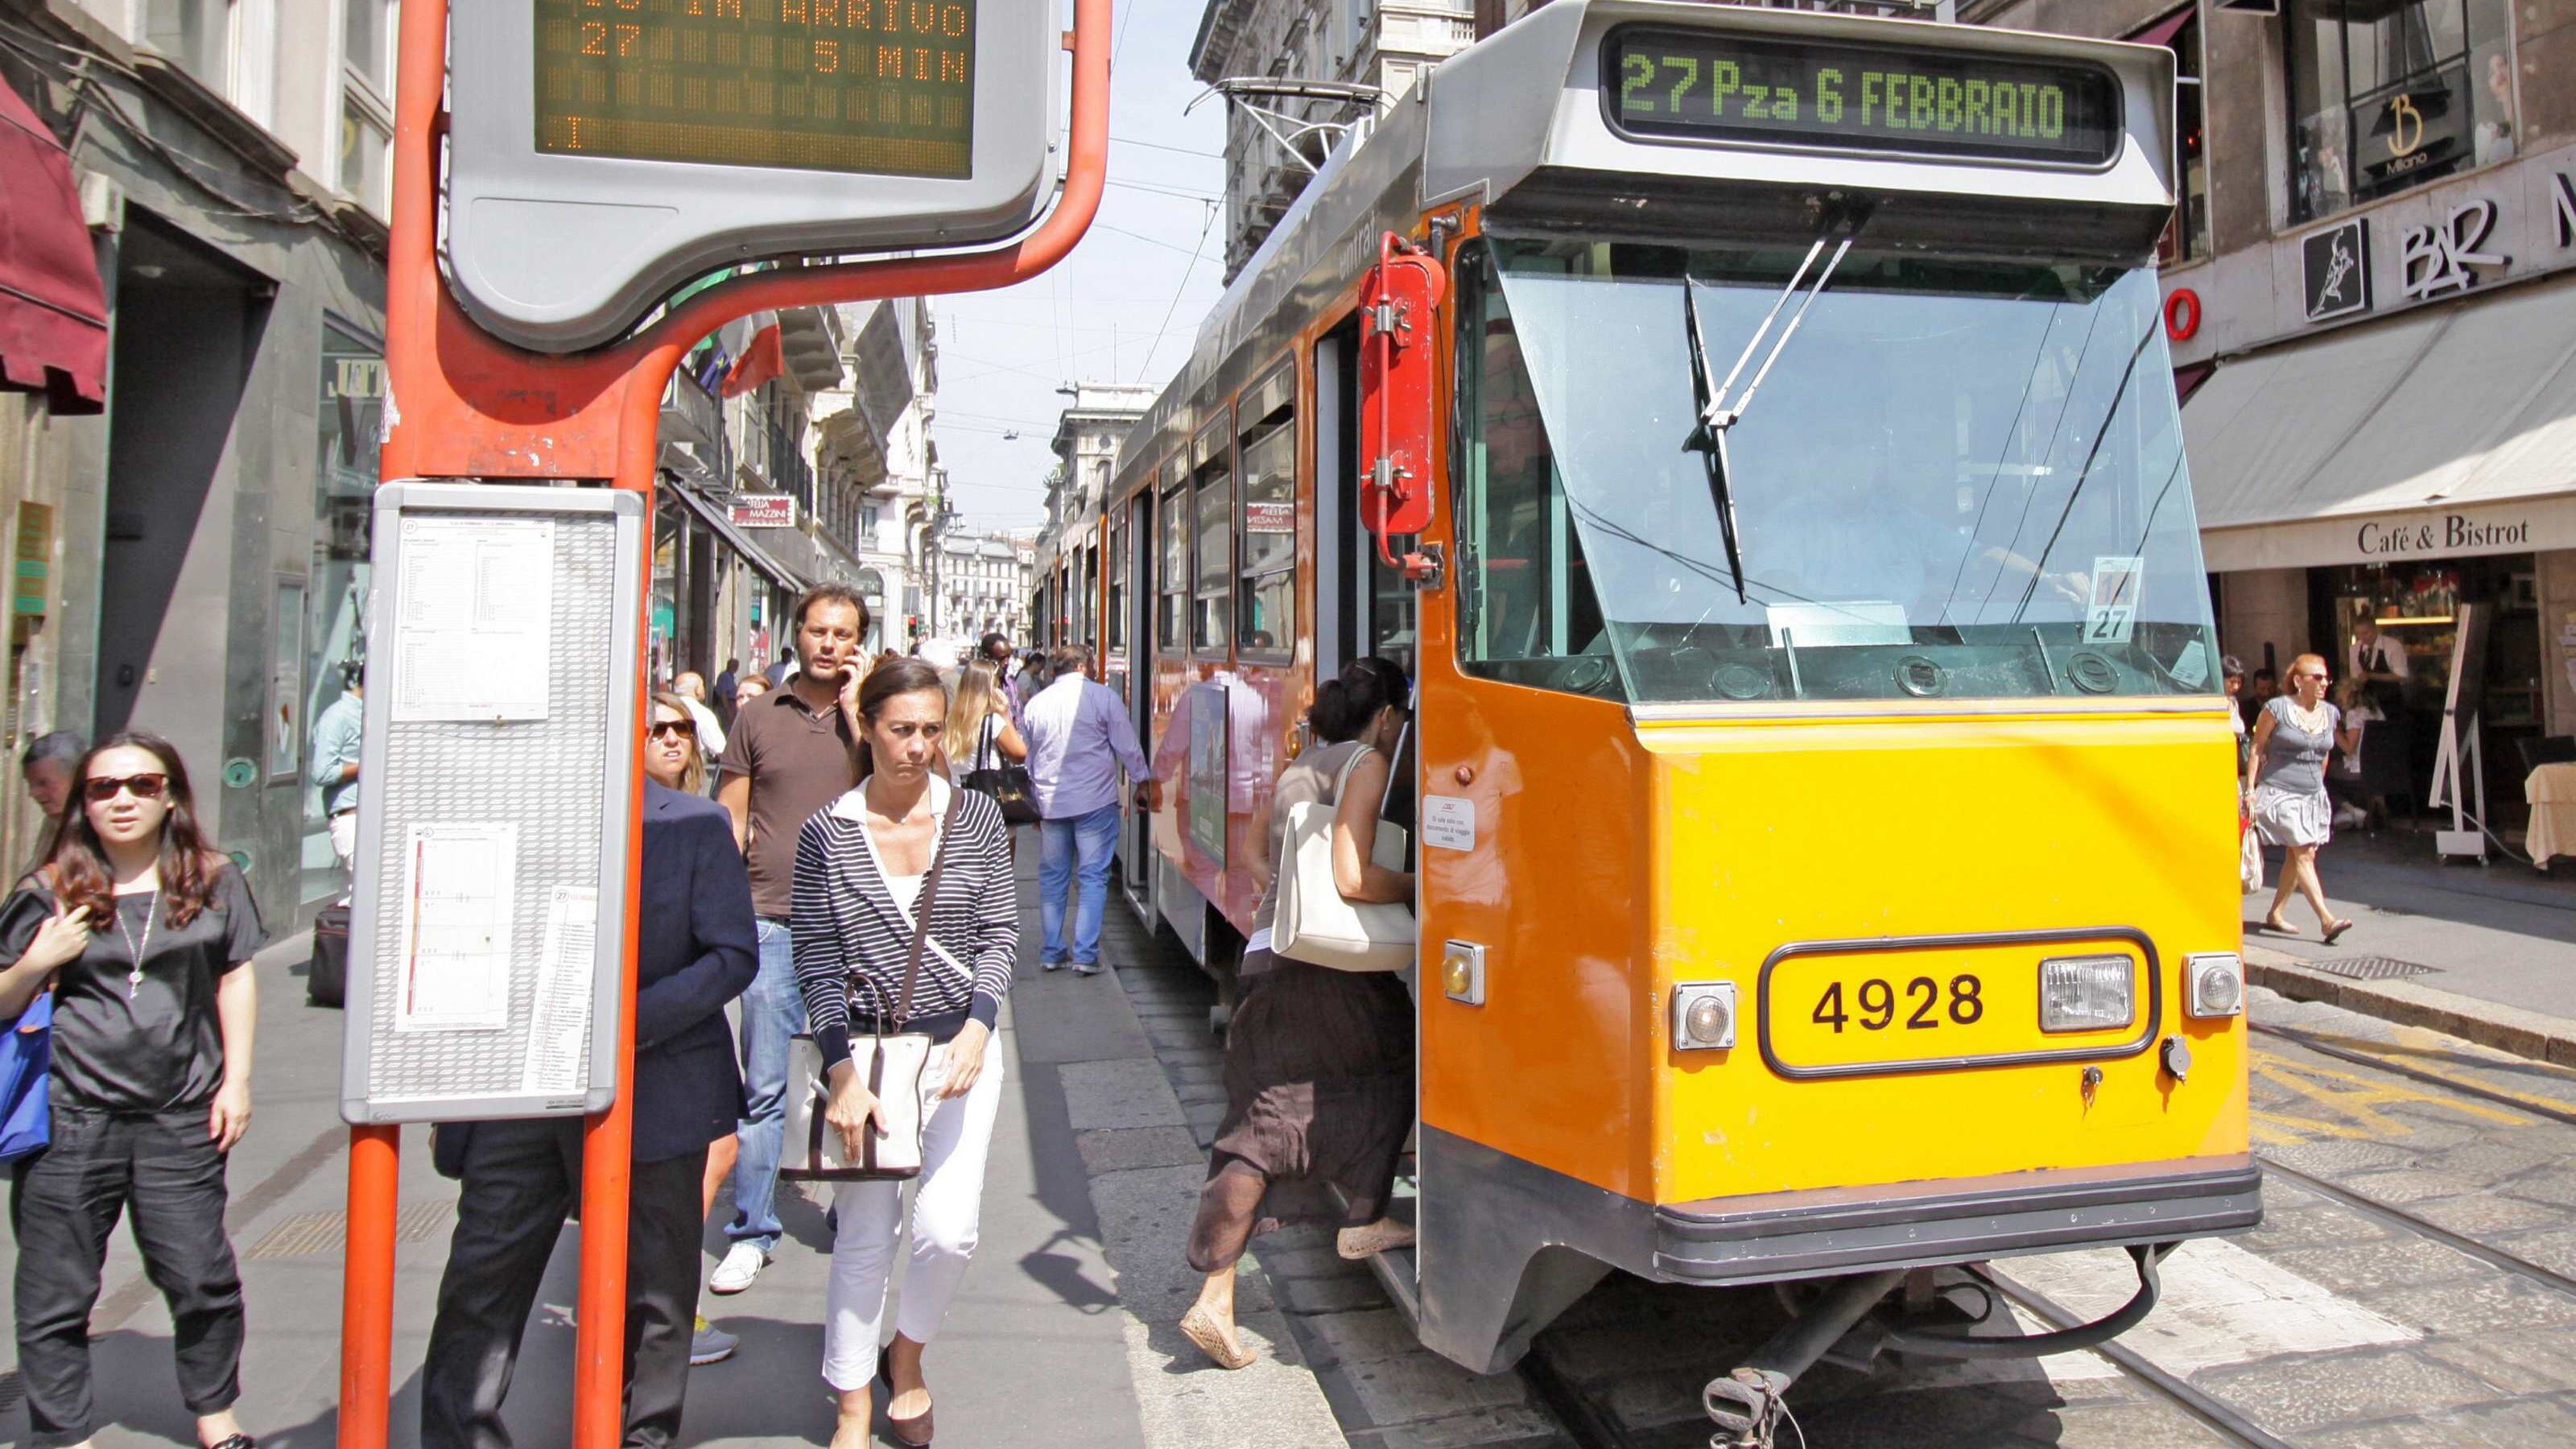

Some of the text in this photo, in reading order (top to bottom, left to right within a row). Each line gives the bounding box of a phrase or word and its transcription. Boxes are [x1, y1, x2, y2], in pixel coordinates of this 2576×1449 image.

[581, 21, 964, 82] 27 5 MIN
[1620, 53, 2064, 139] 27 Pza 6 FEBBRAIO
[2386, 151, 2429, 175] Milano
[2401, 198, 2512, 300] BAR
[749, 509, 786, 518] MAZZINI
[2357, 514, 2529, 555] Café & Bistrot
[2091, 609, 2128, 638] 27
[1812, 973, 1984, 1034] 4928
